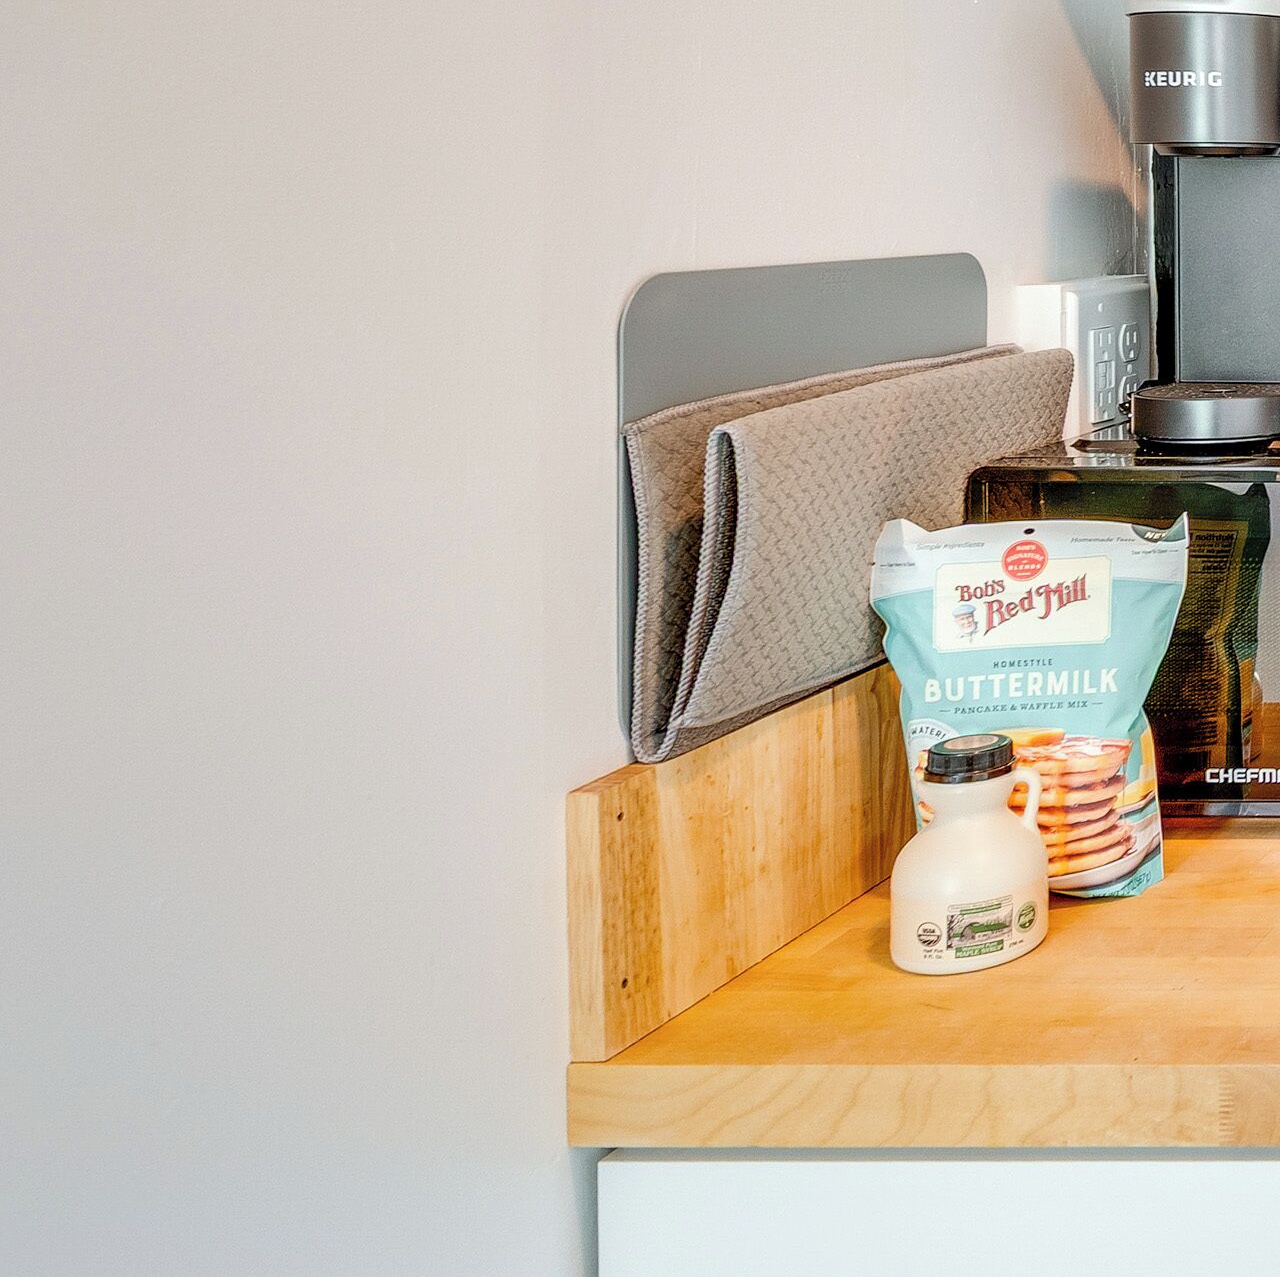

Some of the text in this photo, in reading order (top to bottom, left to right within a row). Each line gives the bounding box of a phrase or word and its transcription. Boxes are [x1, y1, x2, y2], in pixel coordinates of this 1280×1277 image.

[1144, 71, 1222, 87] KEURIG
[1144, 530, 1168, 540] NE
[1007, 563, 1041, 571] BLENDS
[955, 579, 1006, 603] Bob's
[983, 573, 1088, 636] Red Mill
[993, 658, 1053, 668] HOMESTYLE
[924, 667, 1120, 703] BUTTERMILK
[953, 700, 1089, 715] PANCAKE & WAFFLE MIX
